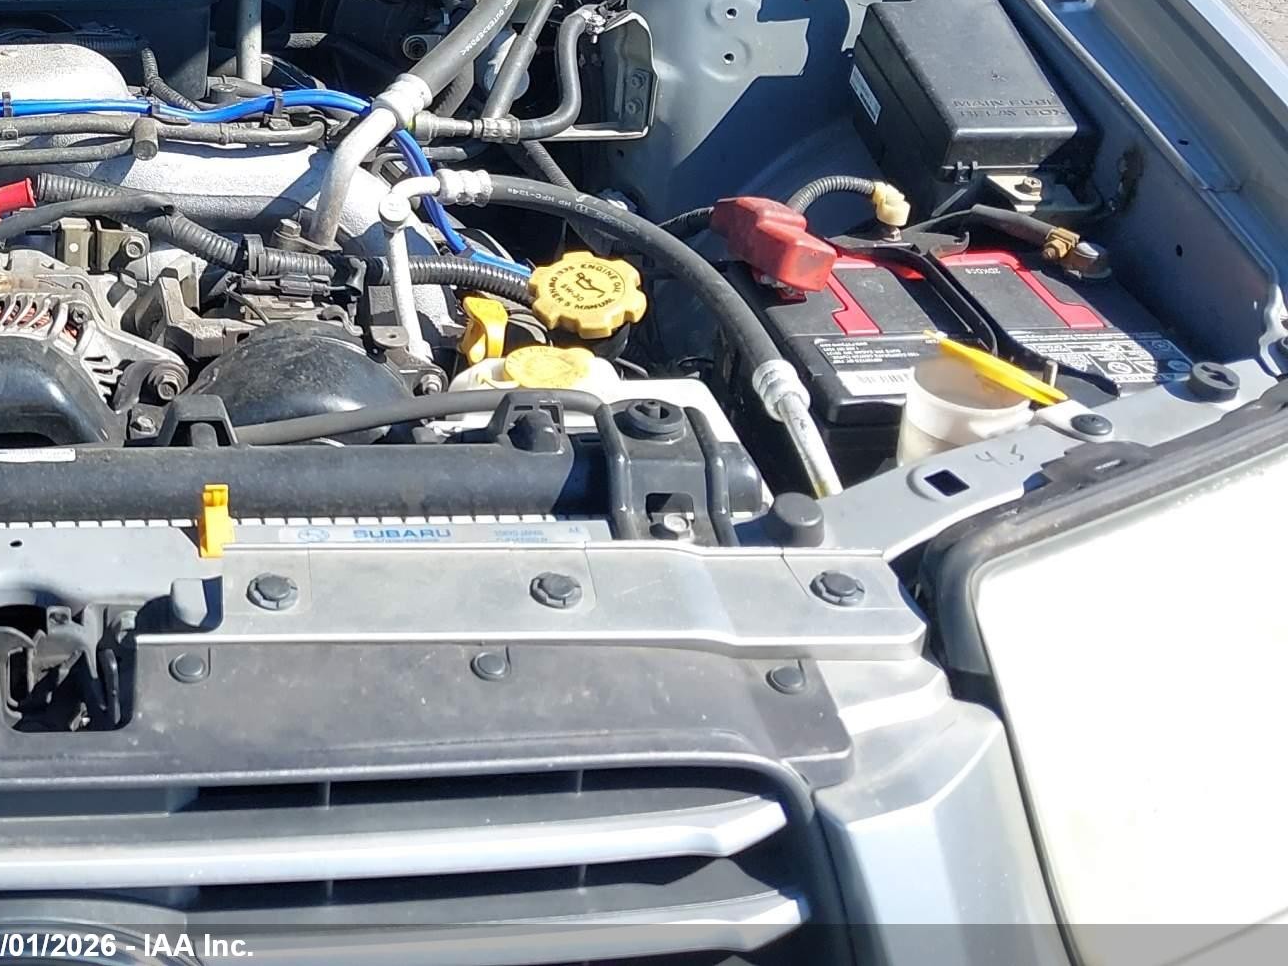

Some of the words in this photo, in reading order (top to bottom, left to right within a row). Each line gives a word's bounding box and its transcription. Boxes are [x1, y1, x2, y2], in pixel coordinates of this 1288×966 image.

[580, 263, 618, 280] ENGINE
[612, 281, 622, 294] OIL
[574, 298, 616, 310] MANUAL
[353, 527, 452, 539] SUBARU
